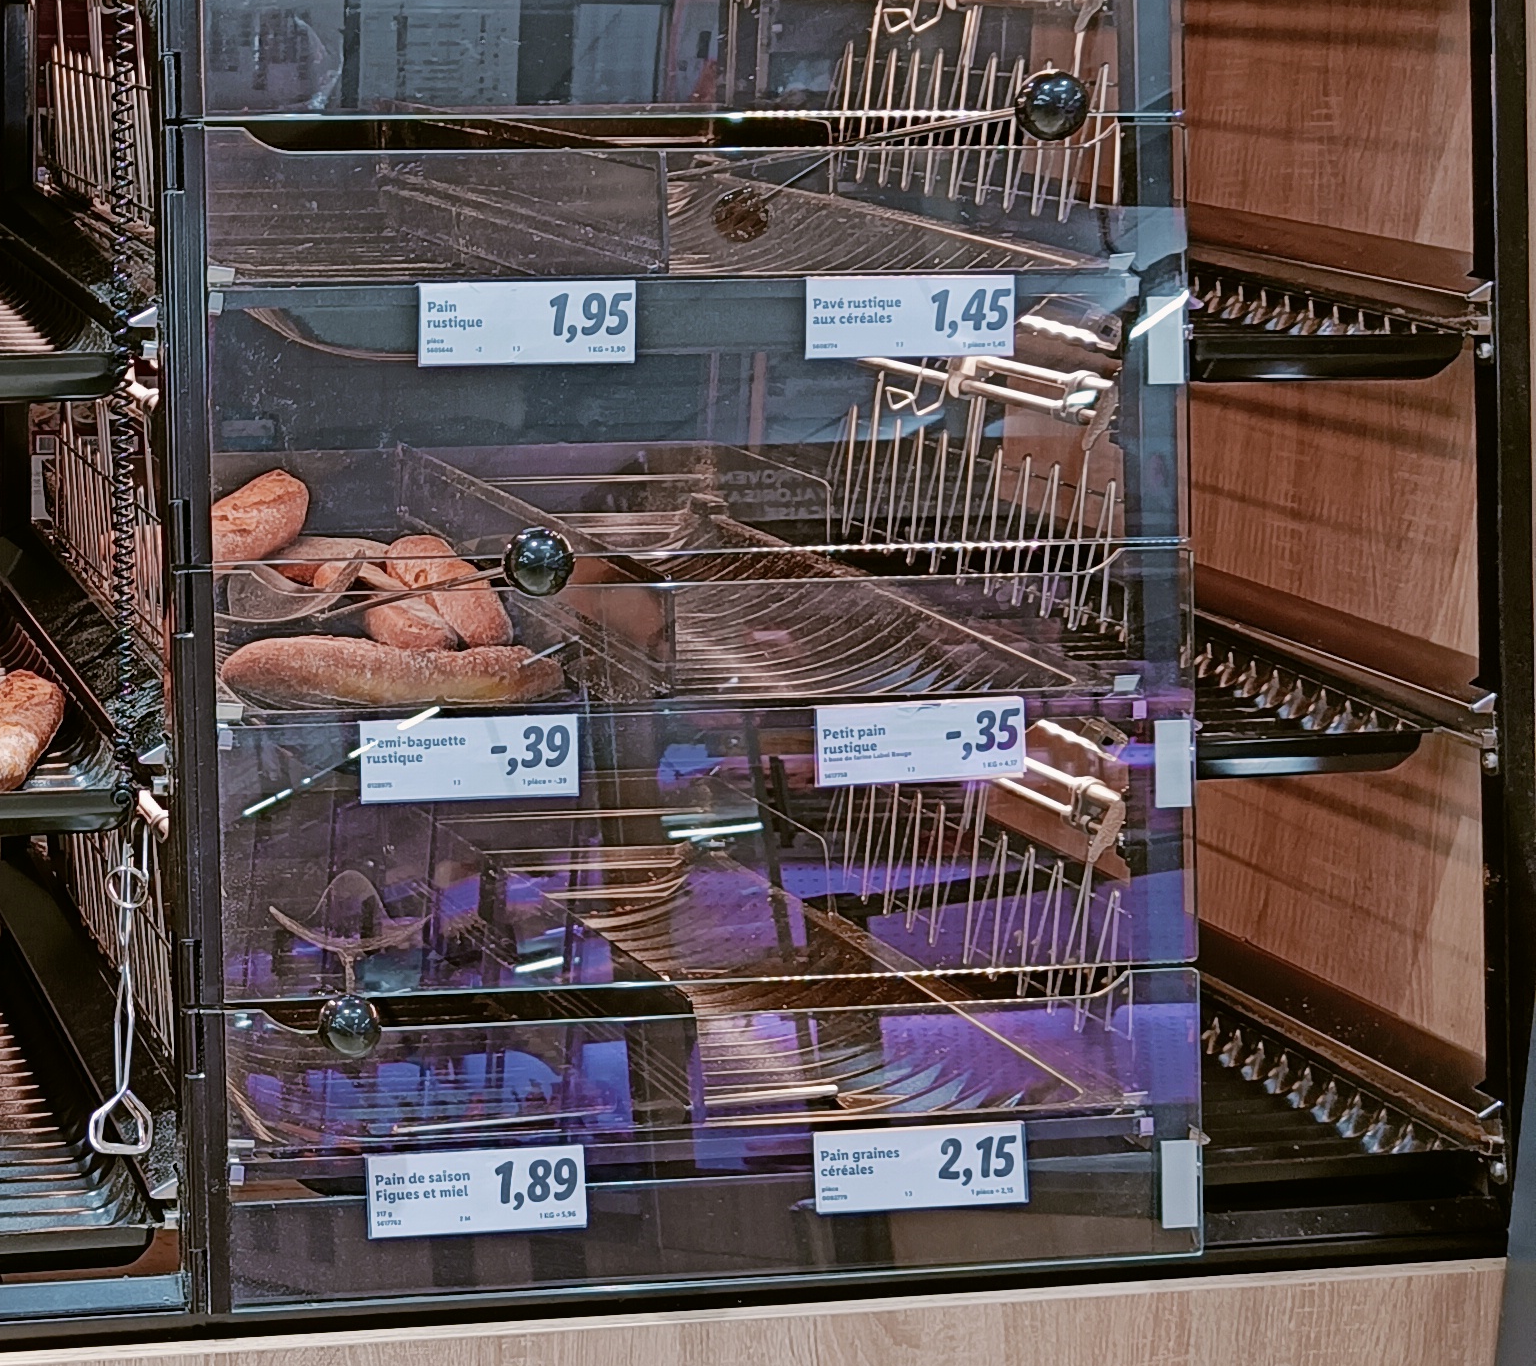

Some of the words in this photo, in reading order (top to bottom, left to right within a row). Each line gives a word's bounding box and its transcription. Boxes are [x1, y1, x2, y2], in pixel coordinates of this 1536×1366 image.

[427, 300, 457, 313] Pain
[813, 297, 844, 310] Pavé
[847, 296, 902, 311] rustique
[549, 292, 633, 343] 1,95
[813, 315, 836, 325] aux
[839, 312, 892, 324] céréales
[931, 288, 1011, 338] 1,45
[427, 316, 483, 331] rustique
[823, 726, 854, 740] Petit
[858, 724, 886, 739] pain
[946, 707, 1021, 761] -,35
[491, 724, 571, 776] -,39
[823, 742, 877, 757] rustique
[366, 751, 423, 766] rustique
[820, 1149, 849, 1162] Pain
[853, 1147, 900, 1163] graines
[938, 1135, 1017, 1187] 2,15
[375, 1173, 405, 1186] Pain
[408, 1172, 425, 1185] de
[429, 1170, 471, 1183] saison
[821, 1164, 874, 1177] céréales
[494, 1157, 578, 1211] 1,89
[376, 1189, 420, 1204] Figues
[423, 1188, 436, 1199] et
[440, 1185, 469, 1198] miel
